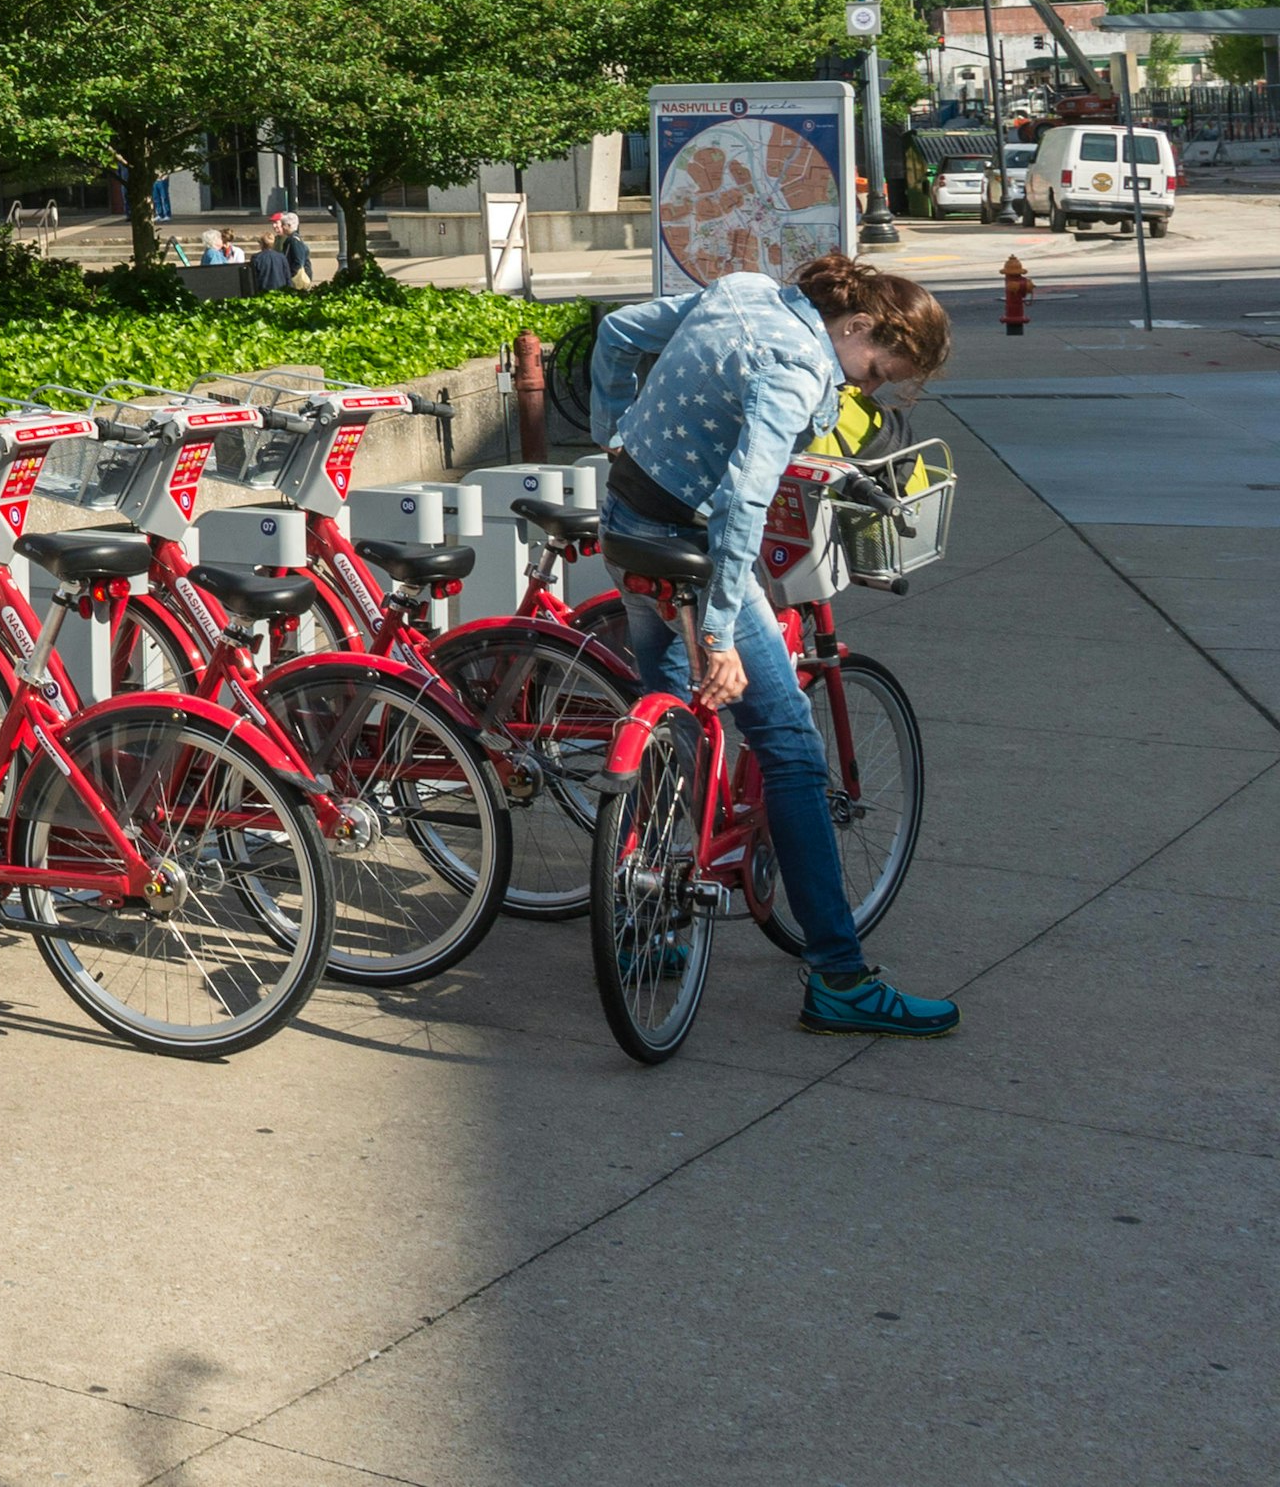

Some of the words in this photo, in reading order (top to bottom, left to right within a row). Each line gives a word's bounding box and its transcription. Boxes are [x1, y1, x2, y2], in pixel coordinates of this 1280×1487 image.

[661, 102, 728, 113] NASHVILLE
[525, 479, 536, 489] 09
[402, 501, 414, 511] 08
[262, 522, 274, 532] 07
[775, 551, 784, 561] B
[338, 559, 376, 617] NASHVILLE
[180, 583, 220, 646] NASHVILLE
